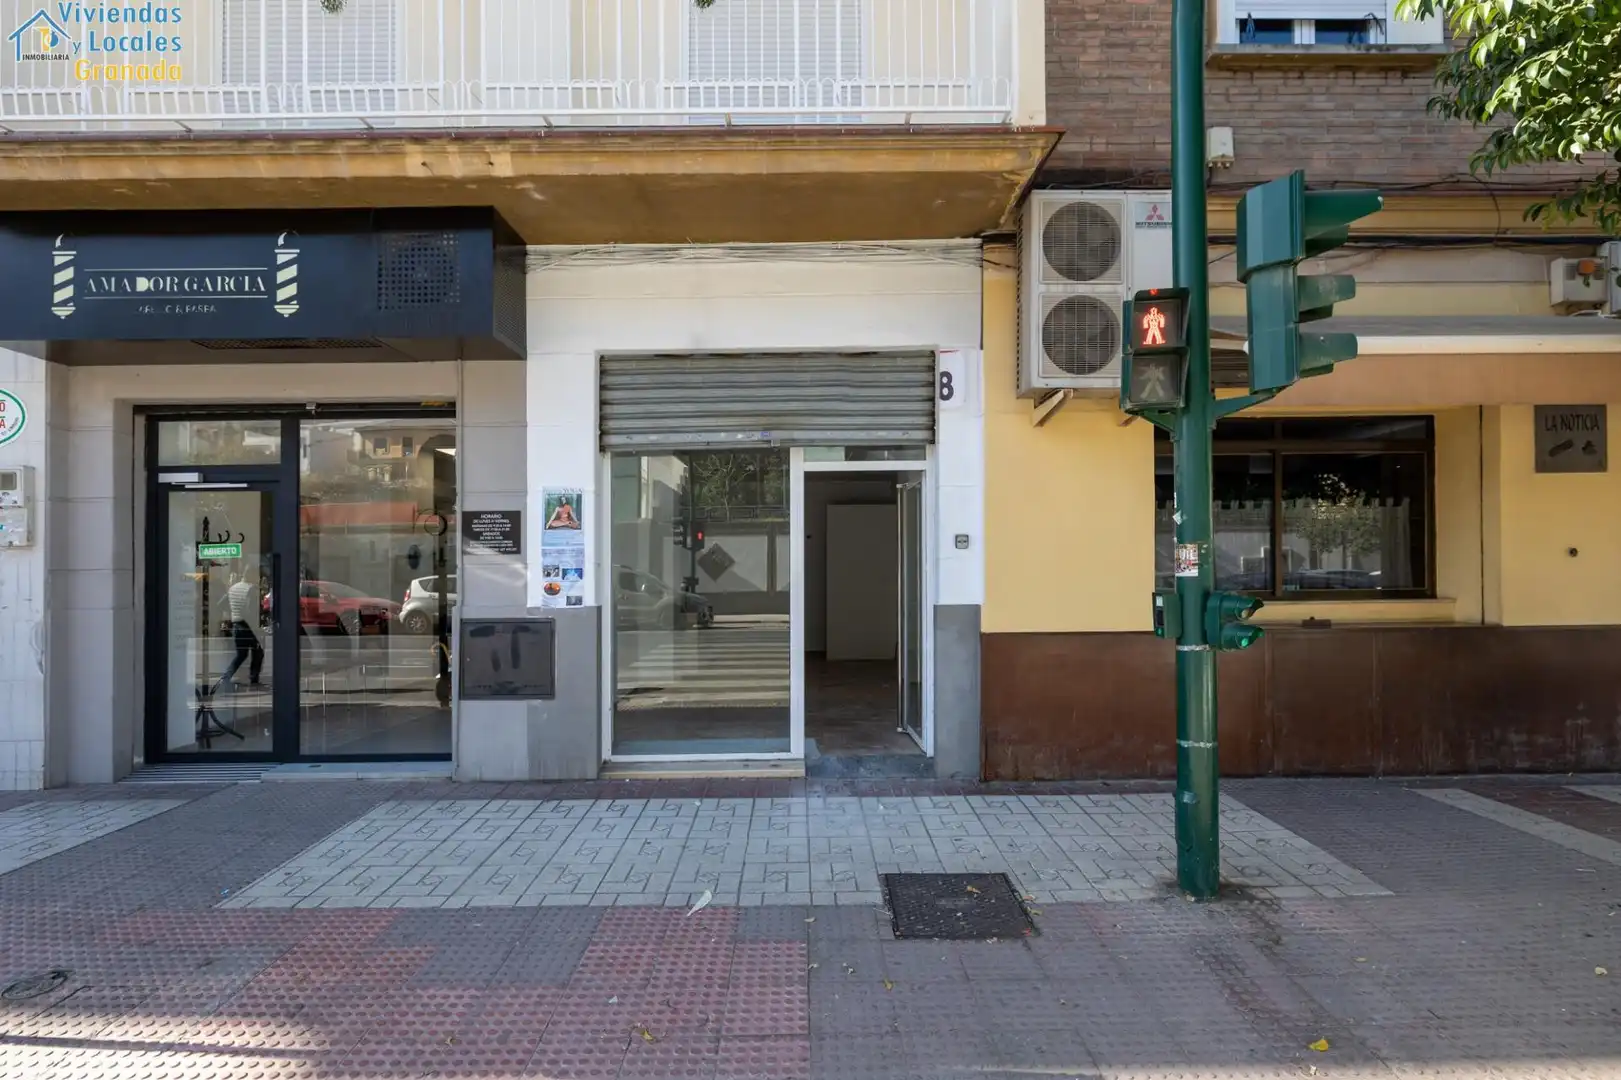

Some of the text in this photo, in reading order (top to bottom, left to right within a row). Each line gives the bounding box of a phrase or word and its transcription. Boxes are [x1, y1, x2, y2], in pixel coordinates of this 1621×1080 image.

[85, 275, 267, 293] AMADOR GARCIA
[939, 371, 954, 401] 8
[1544, 413, 1600, 432] LA NOTICIA
[203, 547, 237, 556] ABIERTO
